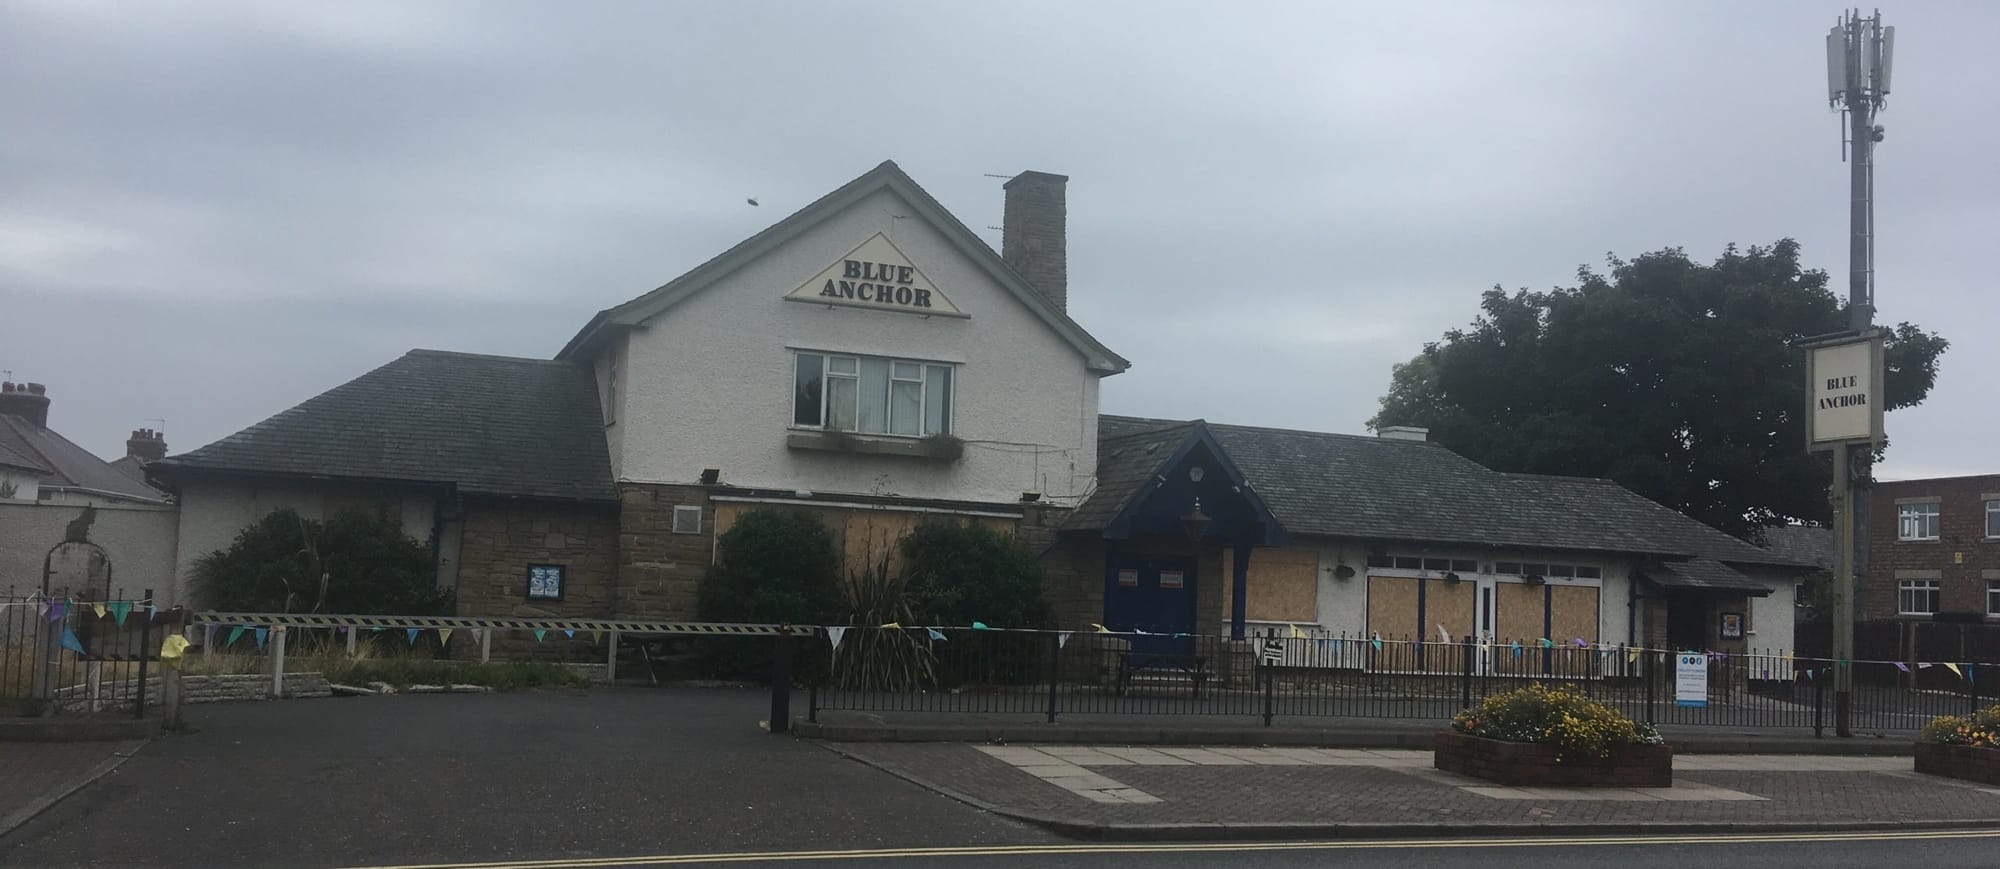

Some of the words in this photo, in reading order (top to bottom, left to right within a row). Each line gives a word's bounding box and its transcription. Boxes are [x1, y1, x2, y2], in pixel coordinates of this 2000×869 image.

[843, 260, 914, 284] BLUE
[819, 279, 932, 307] ANCHOR
[1827, 376, 1857, 390] BLUE
[1818, 394, 1866, 410] ANCHOR
